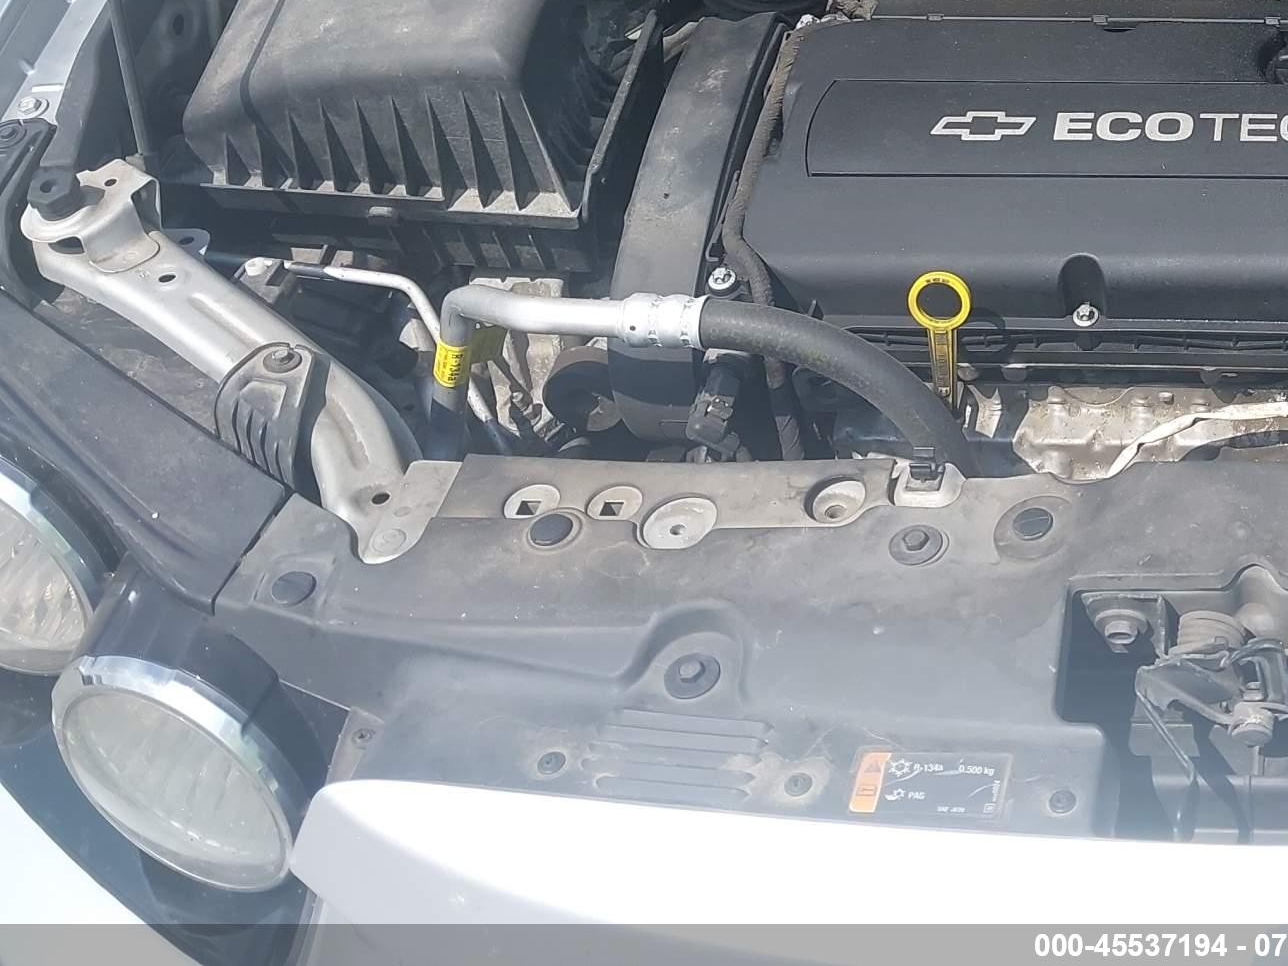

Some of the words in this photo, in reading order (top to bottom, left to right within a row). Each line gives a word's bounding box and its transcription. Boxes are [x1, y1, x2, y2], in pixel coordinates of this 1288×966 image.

[449, 354, 464, 381] R-134a
[913, 763, 944, 773] R-134a
[959, 764, 982, 775] 0.500
[984, 766, 995, 777] kg
[908, 791, 926, 801] PAG
